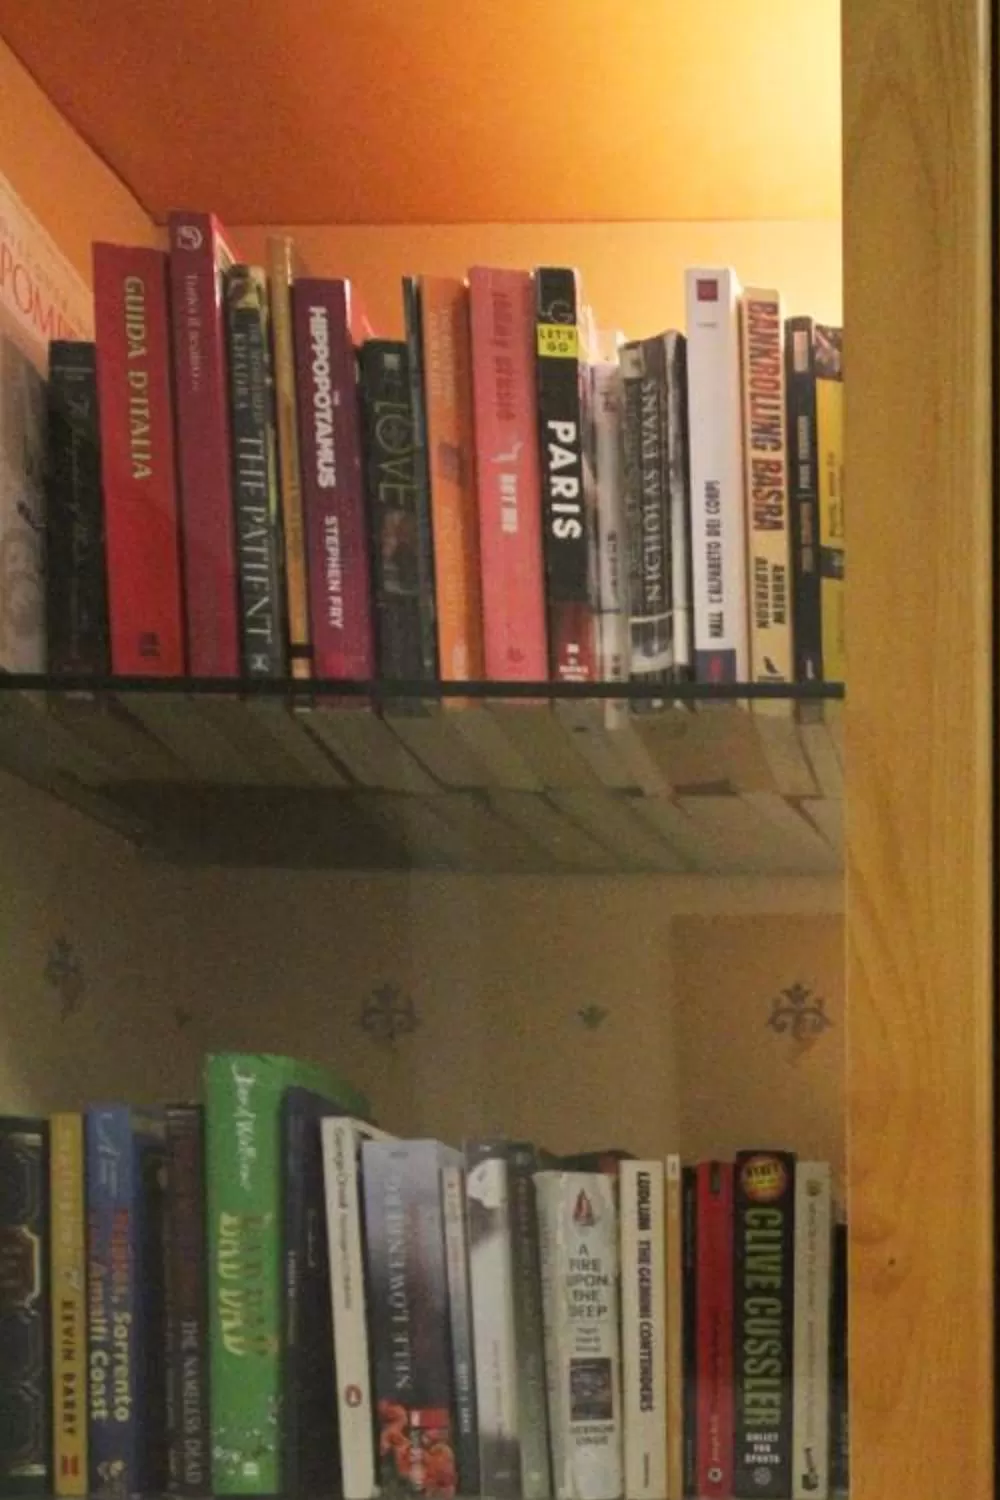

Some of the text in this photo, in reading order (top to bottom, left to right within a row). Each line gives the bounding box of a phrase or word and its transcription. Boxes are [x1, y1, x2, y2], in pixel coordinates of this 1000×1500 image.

[124, 275, 153, 481] GUIDA D'ITALIA
[308, 305, 337, 489] HIPPOPOTAMUS
[747, 300, 786, 533] BANKROLLING BASRA
[236, 433, 266, 498] THE
[547, 420, 582, 539] PARIS
[639, 380, 661, 603] NICHOLAS EVANS
[240, 504, 273, 646] PATIENT
[323, 514, 345, 630] STEPHEN FRY
[637, 1169, 652, 1232] LUDLUM
[61, 1298, 77, 1362] KEVIN
[112, 1310, 132, 1423] Sorrento
[743, 1206, 784, 1429] CLIVE CUSSLER
[89, 1347, 109, 1422] Coast
